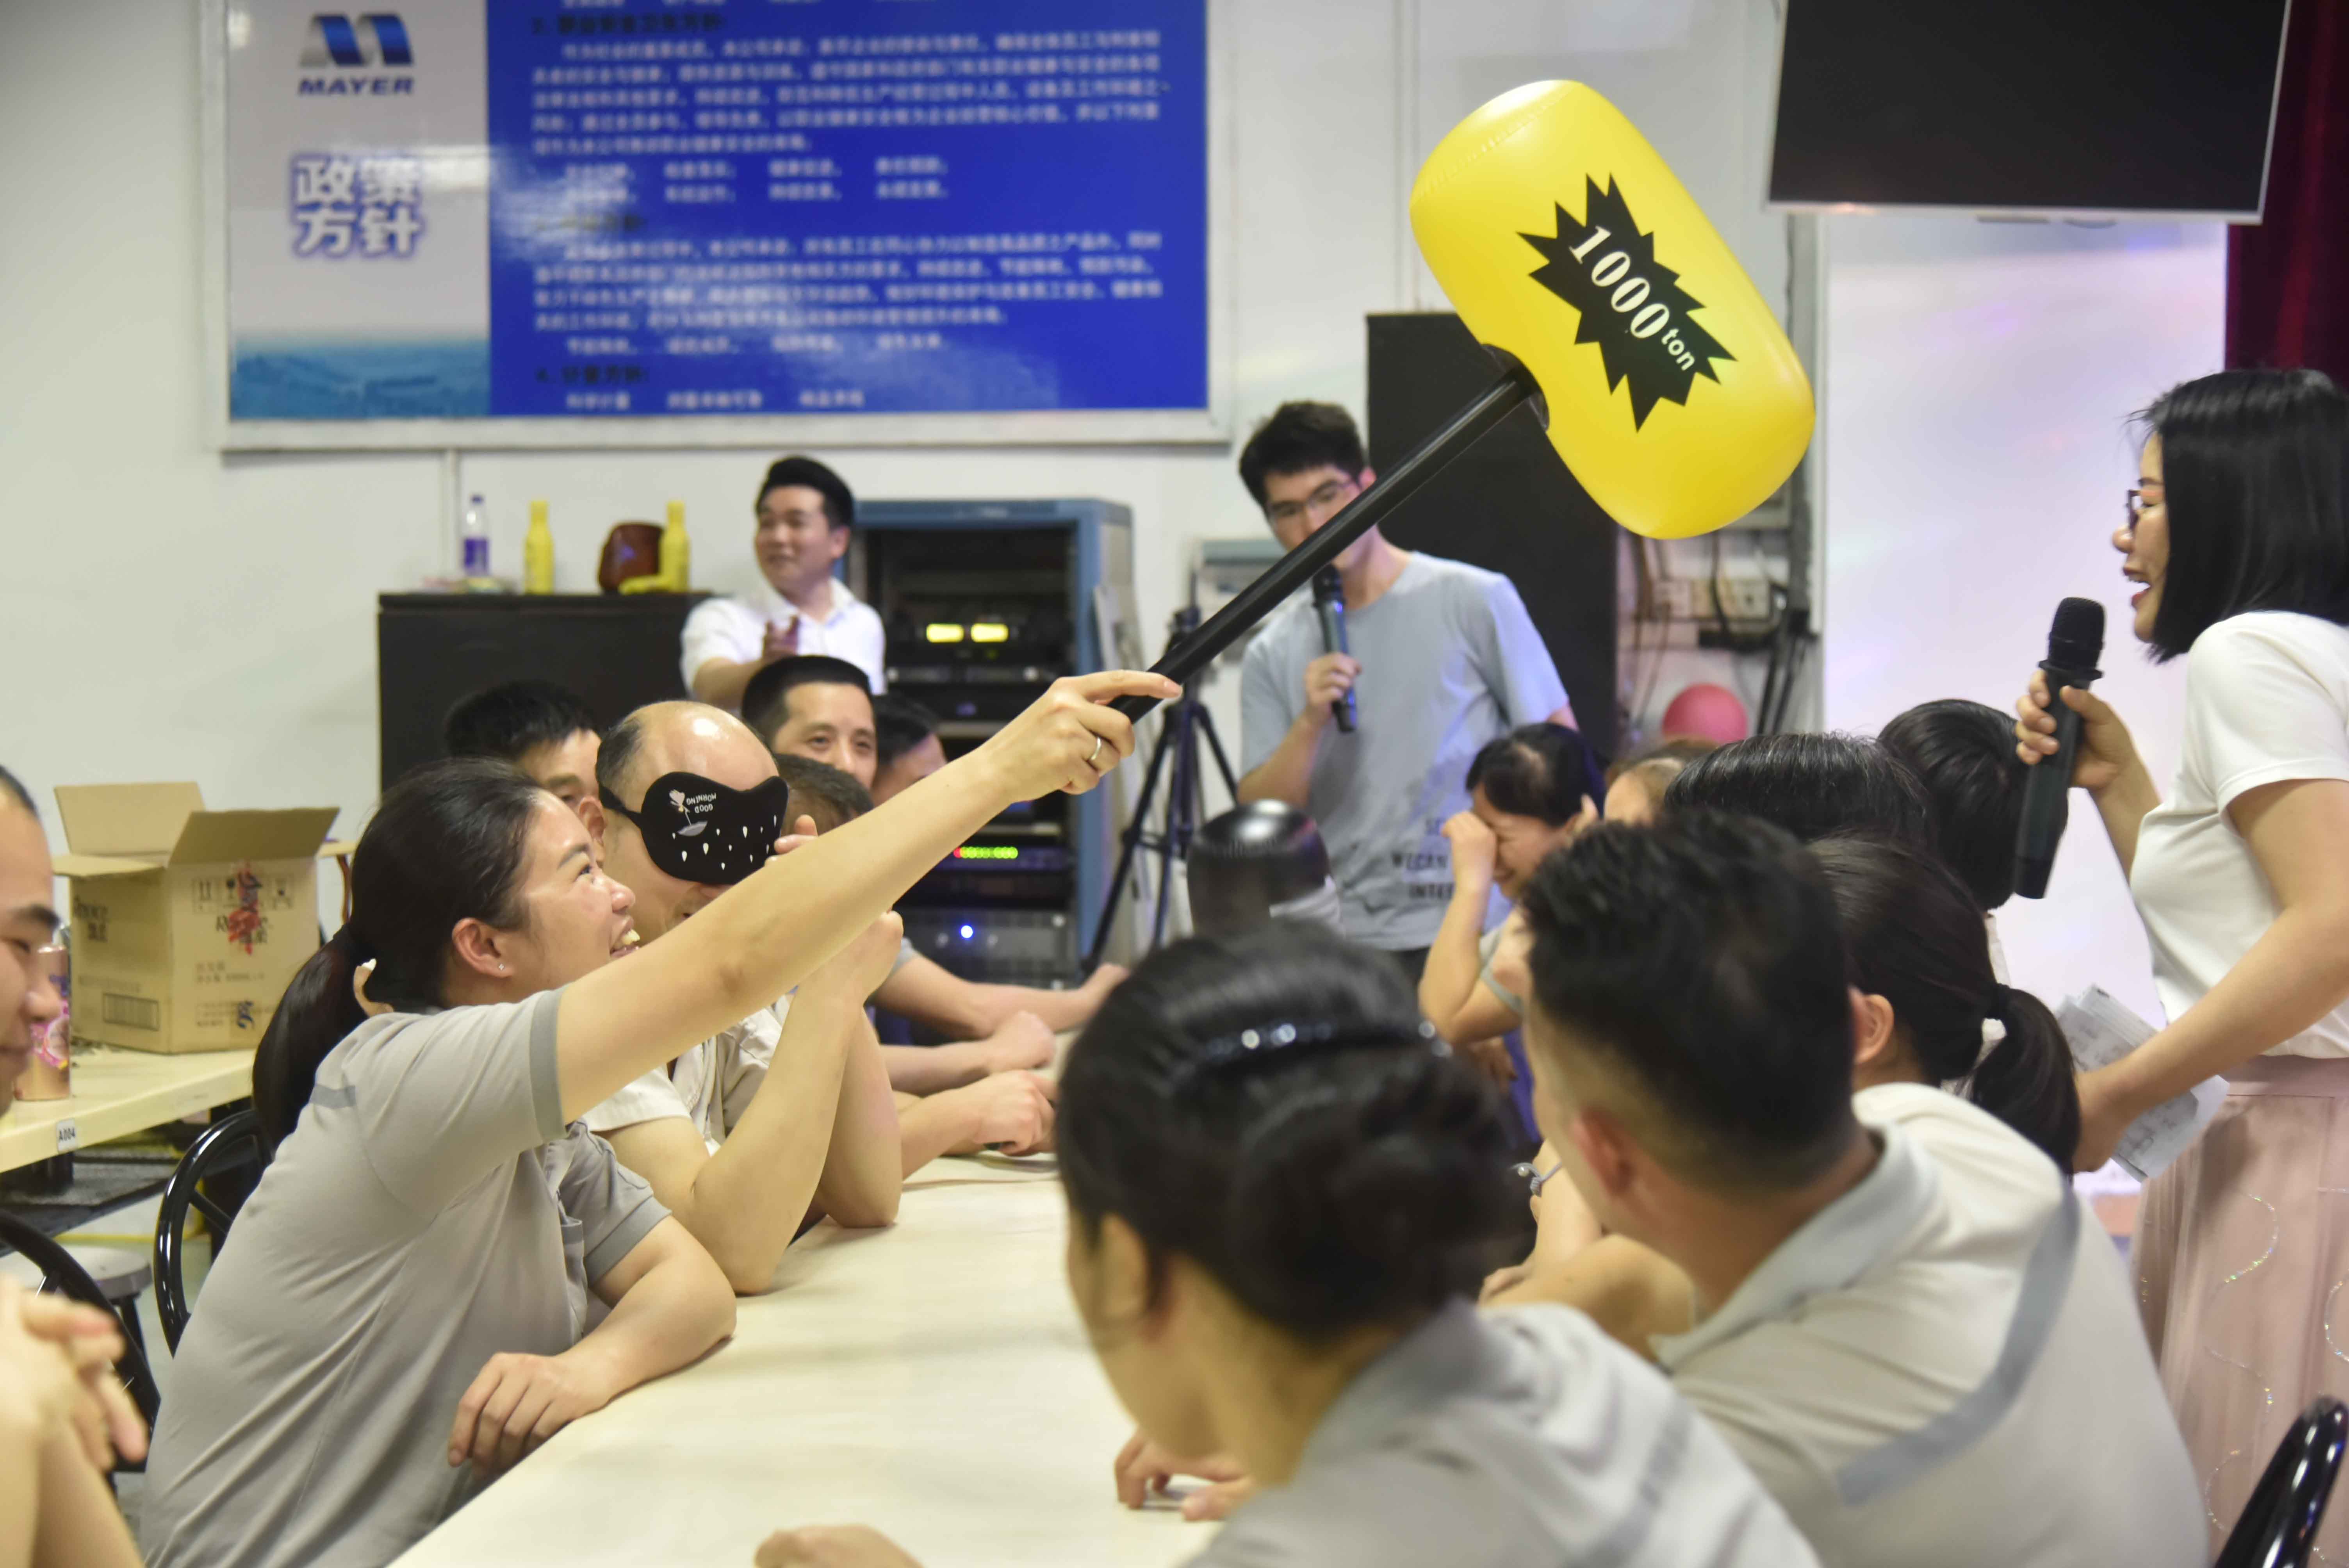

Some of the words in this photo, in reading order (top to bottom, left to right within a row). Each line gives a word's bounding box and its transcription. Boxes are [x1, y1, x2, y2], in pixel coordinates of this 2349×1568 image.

[298, 77, 414, 95] MAYER
[292, 203, 424, 256] 方针
[1569, 225, 1670, 339] 1000
[1661, 328, 1695, 371] ton
[686, 792, 716, 805] MORNING
[695, 803, 713, 813] GOOD
